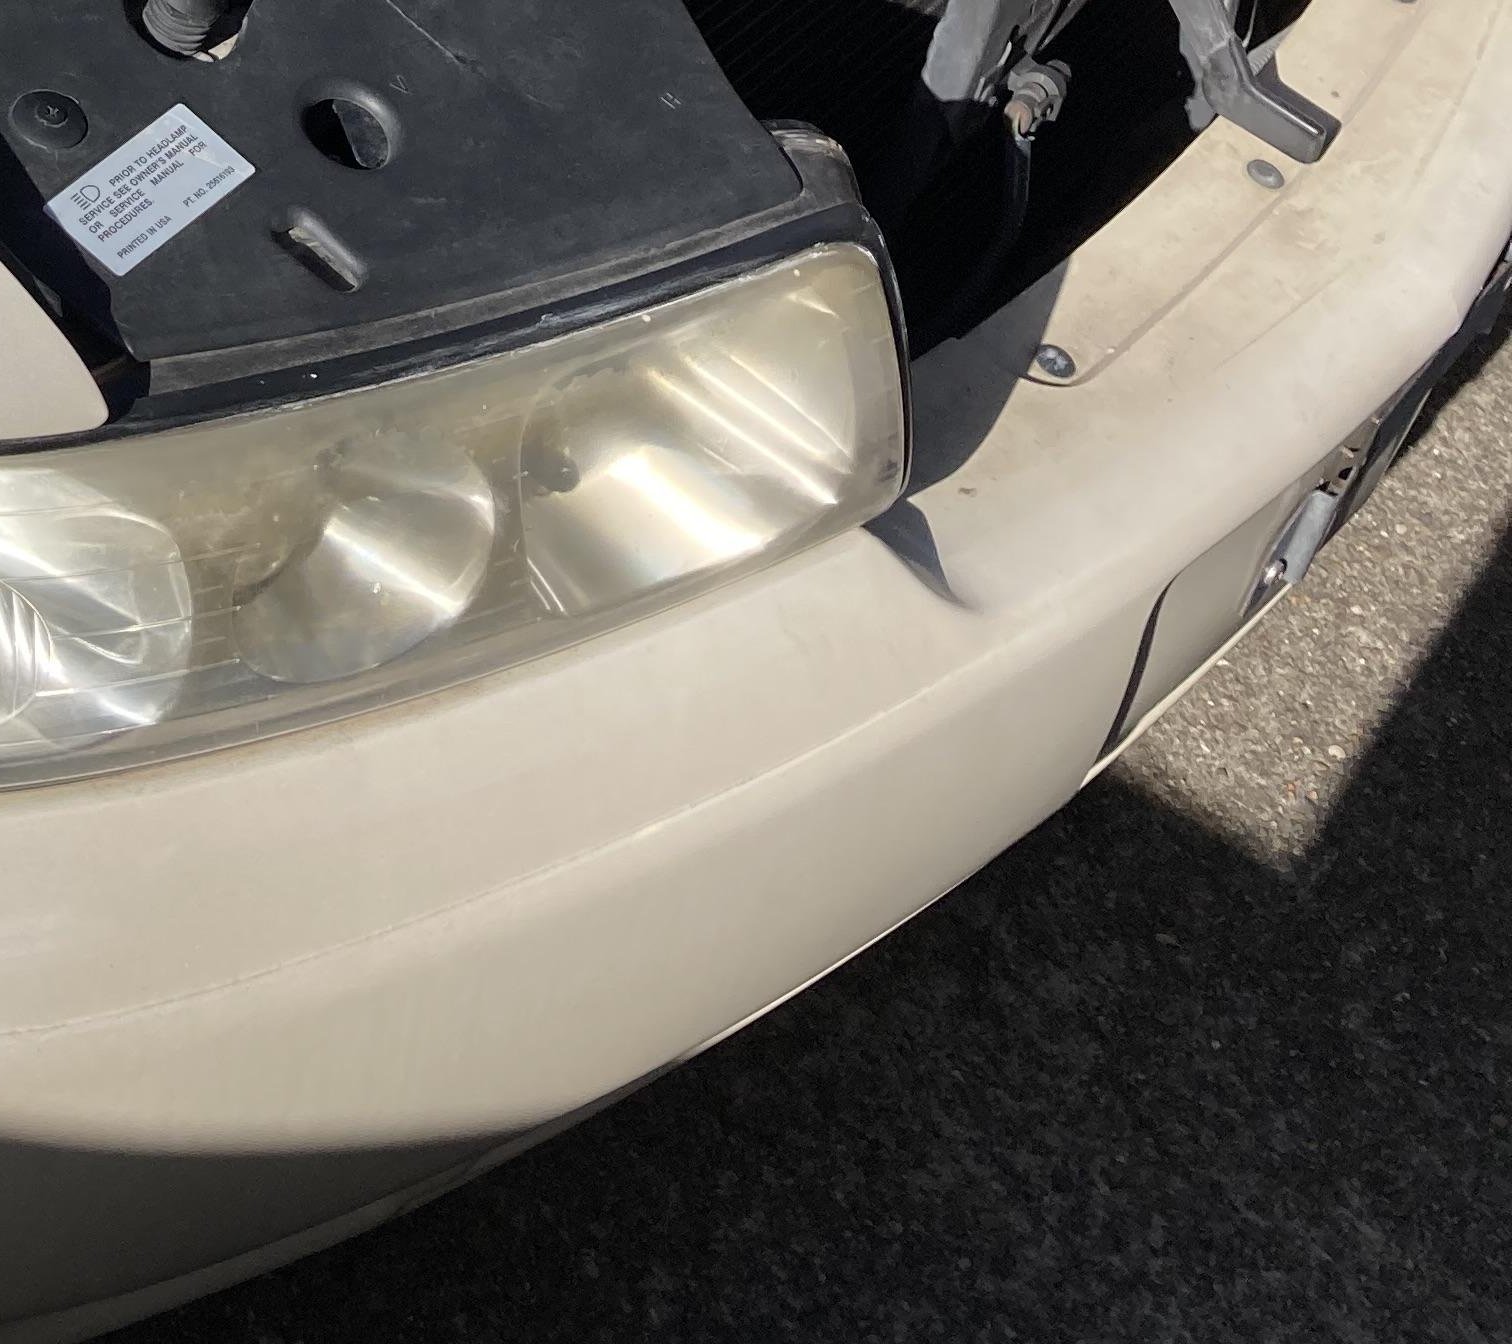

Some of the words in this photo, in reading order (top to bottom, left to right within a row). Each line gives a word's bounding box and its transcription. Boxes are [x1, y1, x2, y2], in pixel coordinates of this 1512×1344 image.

[78, 196, 115, 226] SERVICE
[113, 183, 132, 200] SEE
[130, 156, 167, 186] OWNER'S
[166, 134, 198, 160] MANUAL
[108, 165, 136, 187] PRIOR
[134, 155, 148, 168] TO
[146, 124, 188, 159] HEADLAMP
[88, 220, 105, 234] OR
[109, 188, 146, 218] SERVICE
[150, 160, 184, 187] MANUAL
[188, 141, 207, 157] FOR
[194, 186, 207, 200] NO.
[117, 234, 149, 259] PRINTED
[146, 225, 158, 236] IN
[156, 215, 172, 229] USA
